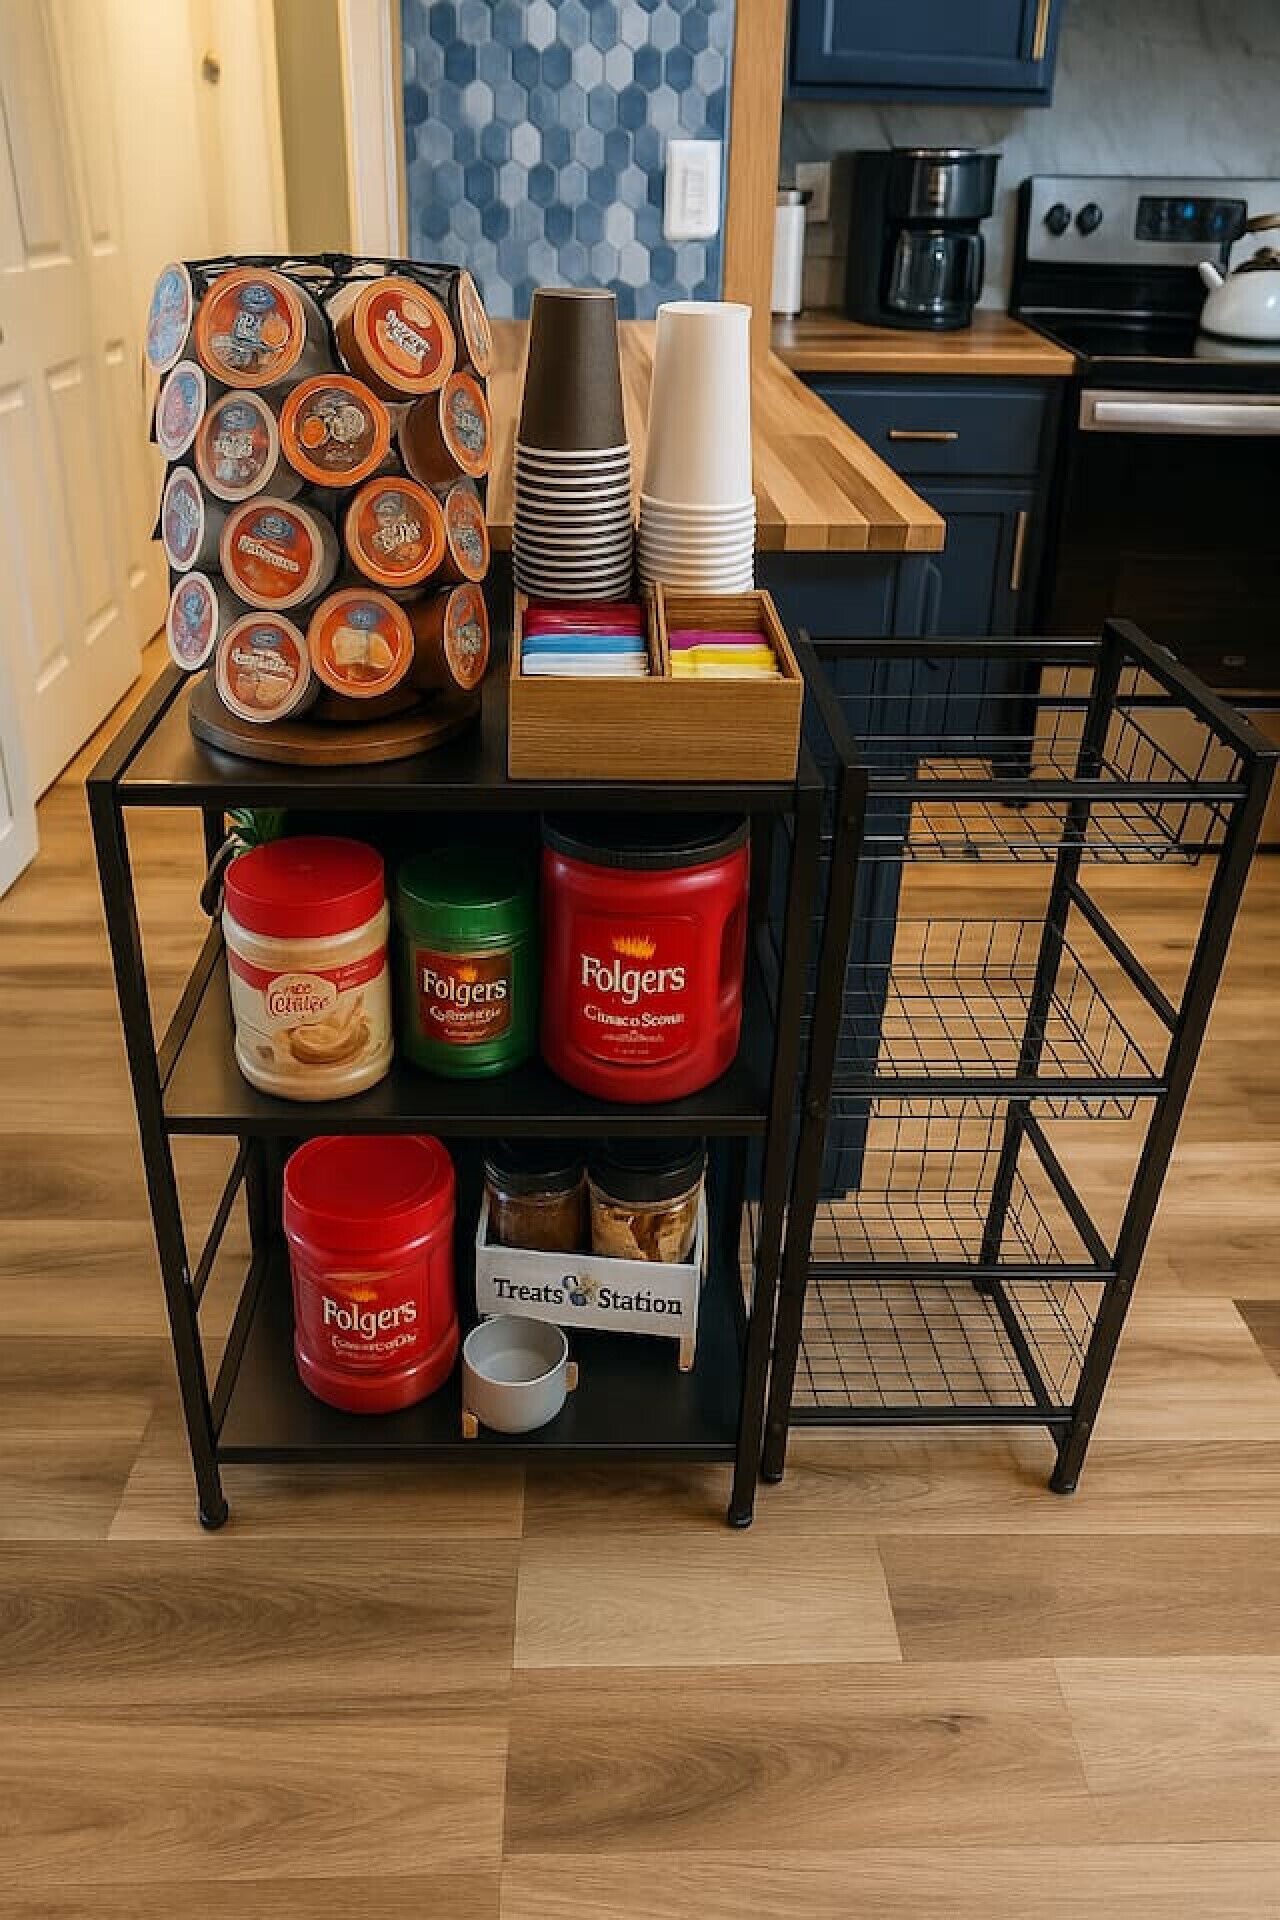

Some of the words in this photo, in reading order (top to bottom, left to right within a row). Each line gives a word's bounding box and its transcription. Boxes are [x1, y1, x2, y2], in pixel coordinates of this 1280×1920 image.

[423, 967, 508, 1008] Folgers
[580, 953, 686, 1005] Folgers
[321, 1295, 417, 1340] Folgers
[493, 1277, 563, 1304] Treats
[597, 1287, 682, 1315] Station
